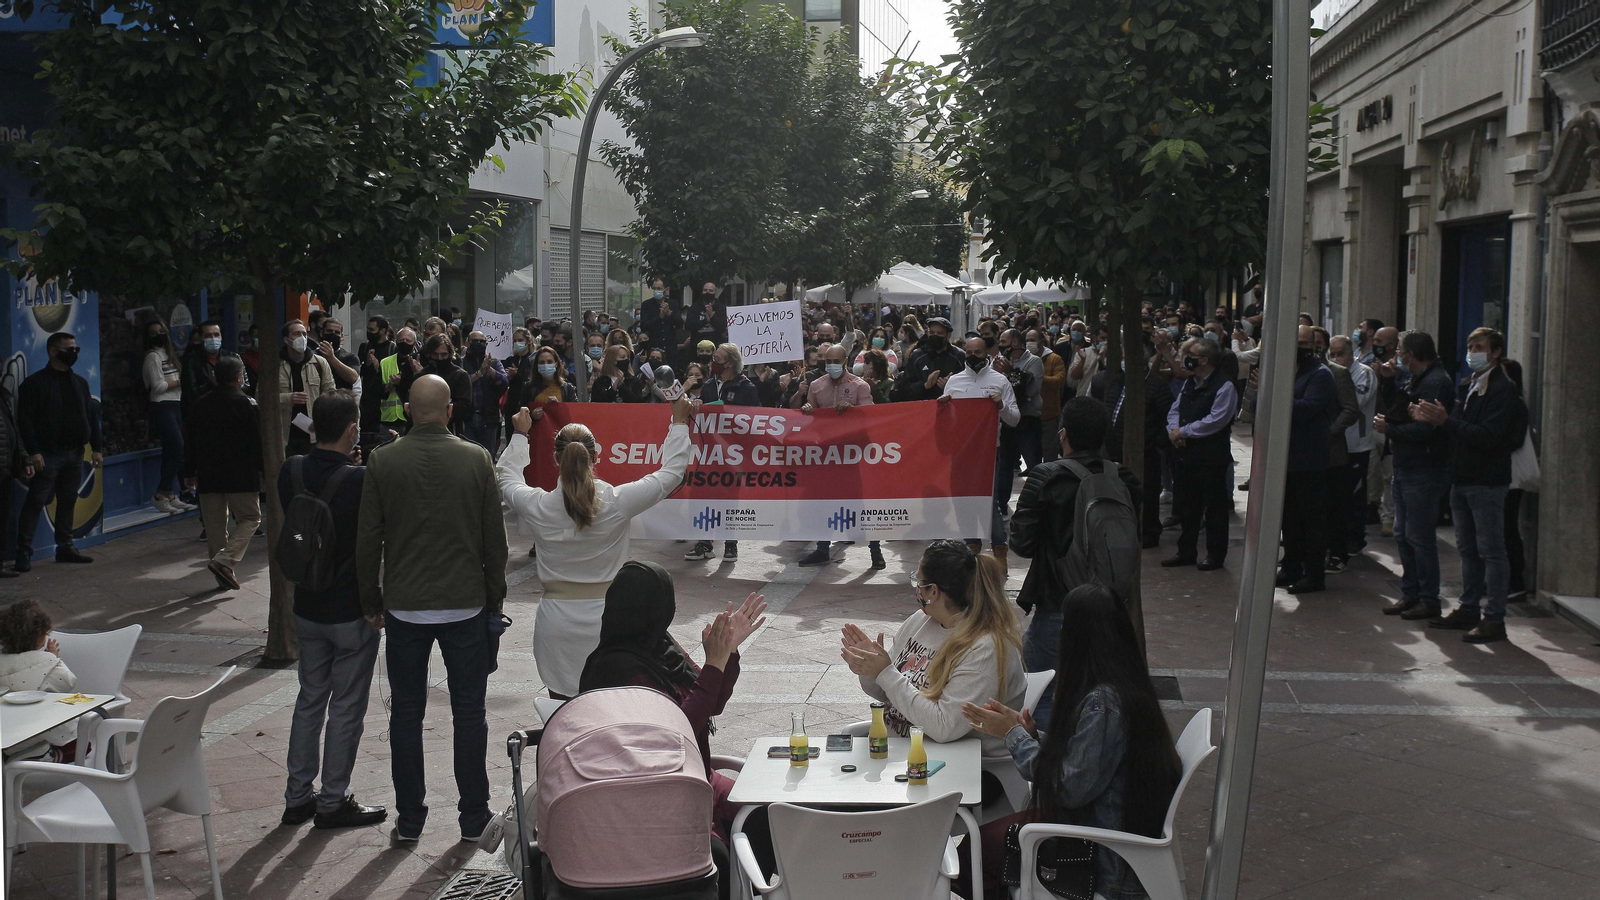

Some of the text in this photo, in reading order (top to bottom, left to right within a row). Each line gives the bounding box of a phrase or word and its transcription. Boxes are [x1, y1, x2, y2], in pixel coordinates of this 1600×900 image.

[757, 326, 771, 336] LA
[693, 412, 786, 436] MESES
[609, 443, 743, 466] SEMNAS
[751, 442, 902, 466] CERRADOS
